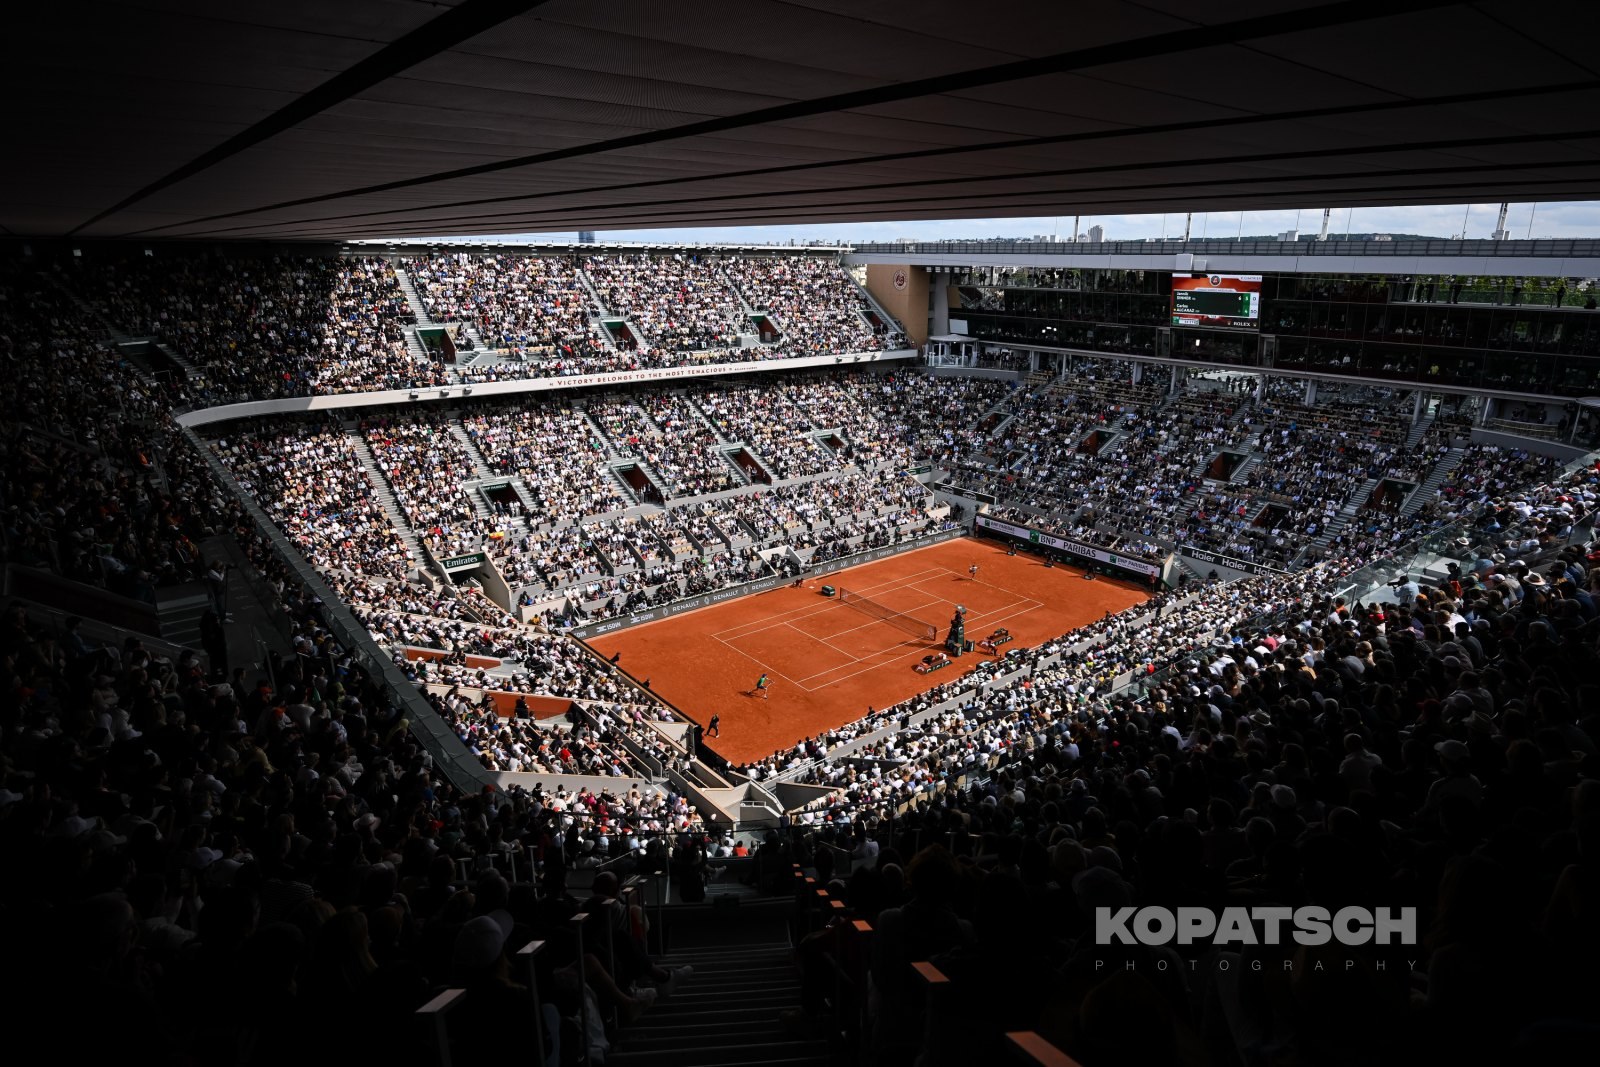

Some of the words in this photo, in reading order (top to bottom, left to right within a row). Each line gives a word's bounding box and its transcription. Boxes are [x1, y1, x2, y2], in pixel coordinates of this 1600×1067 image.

[557, 378, 594, 386] VICTORY
[597, 375, 633, 383] BELONGS
[687, 367, 727, 375] TENACIOUS
[1040, 535, 1056, 546] BNP
[1063, 541, 1096, 558] PARIBAS
[446, 556, 478, 568] Emirates
[1191, 550, 1216, 563] Haier
[1221, 558, 1247, 571] Haier
[751, 580, 776, 591] RENAULT
[713, 590, 739, 601] RENAULT
[672, 600, 700, 612] RENAULT
